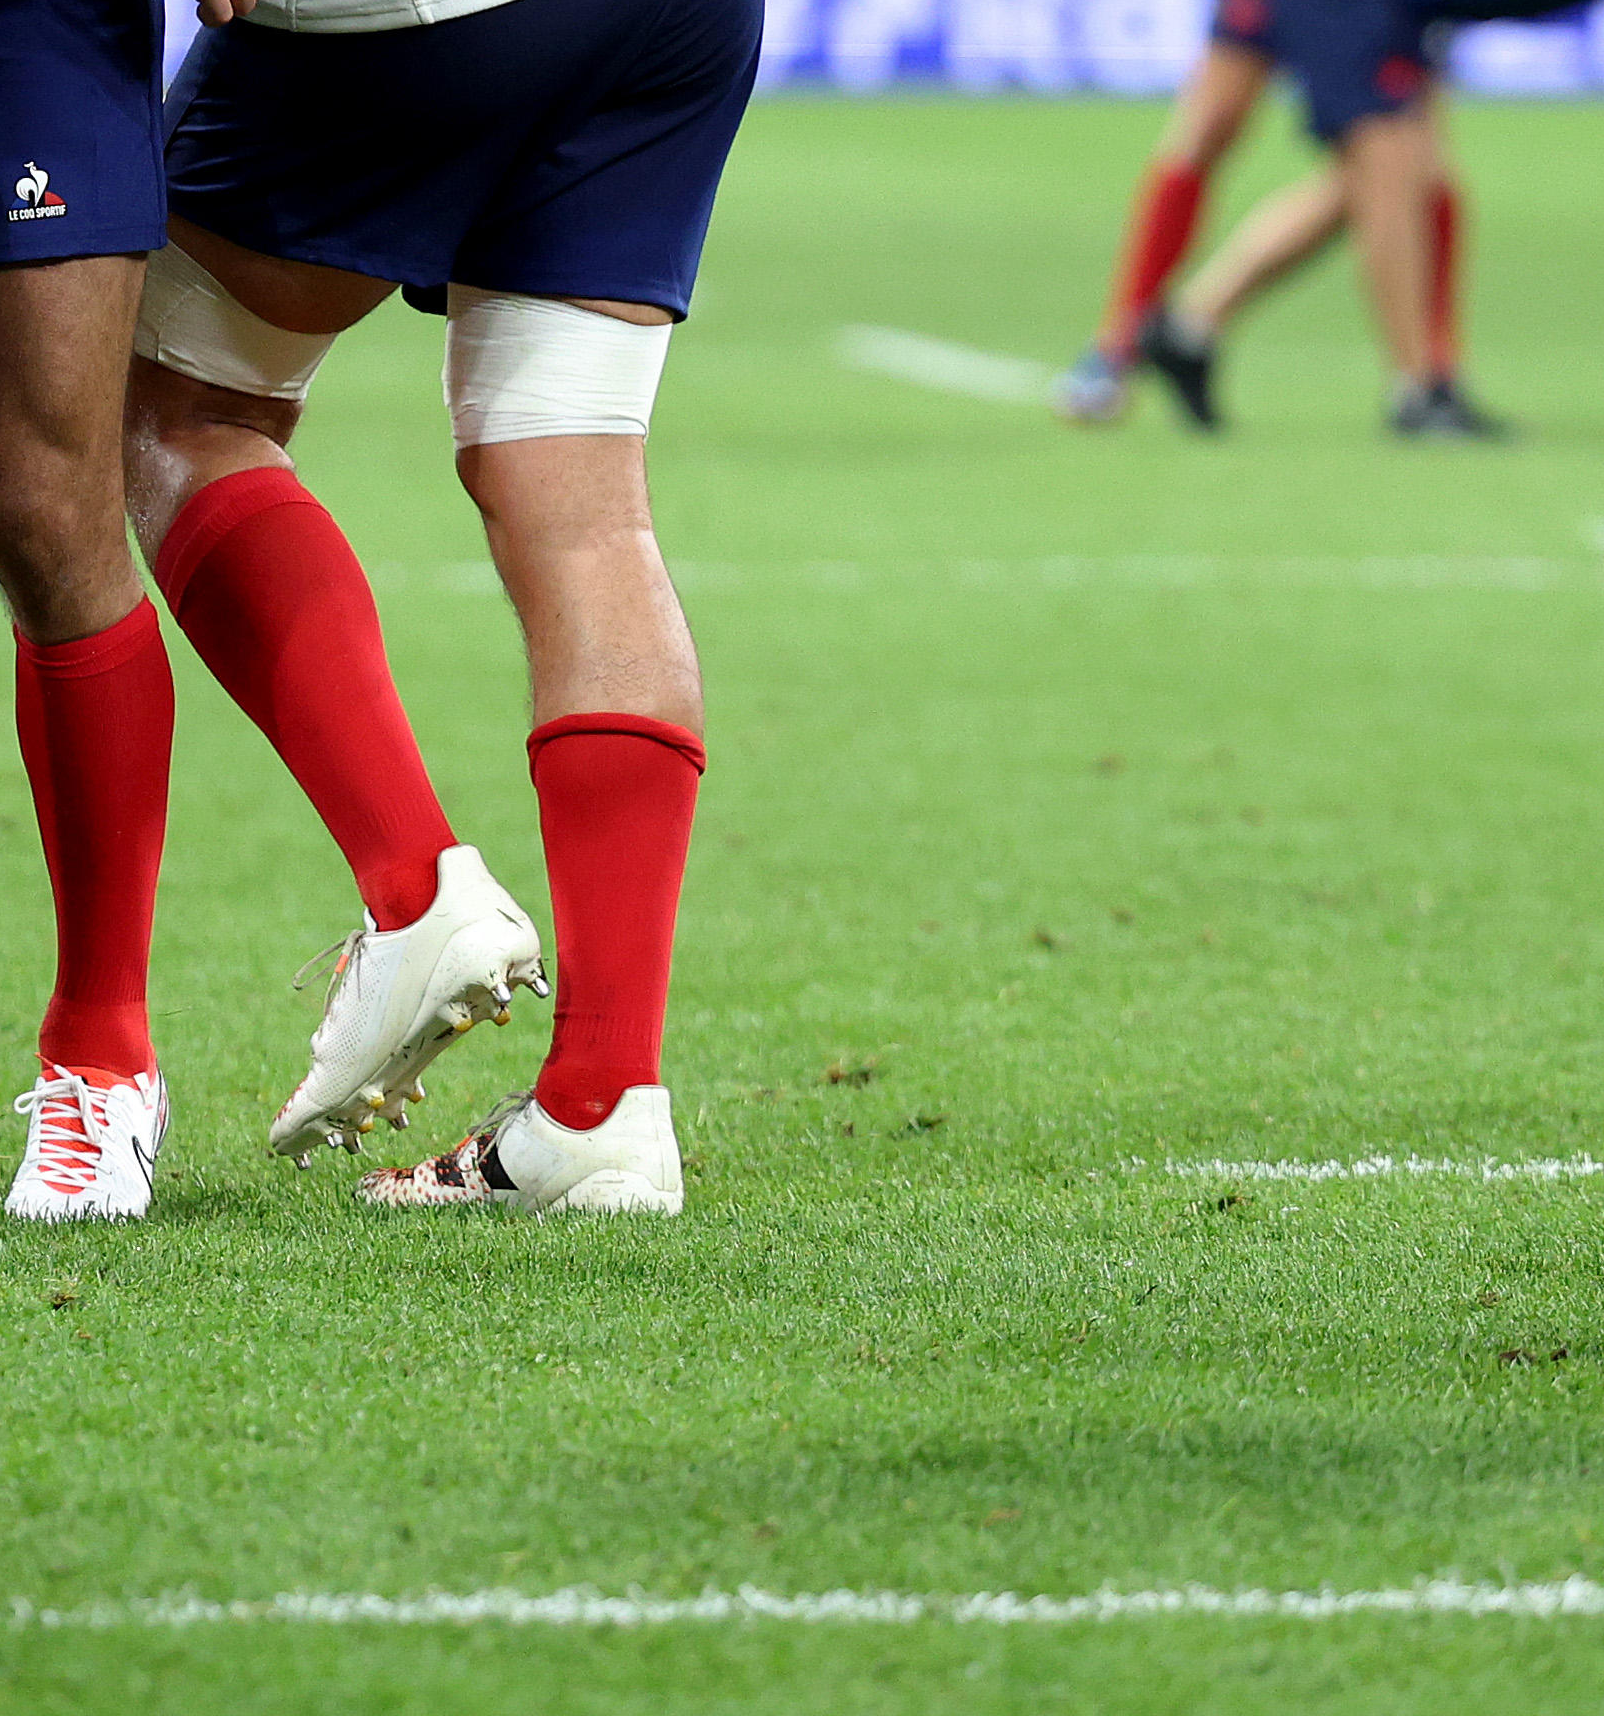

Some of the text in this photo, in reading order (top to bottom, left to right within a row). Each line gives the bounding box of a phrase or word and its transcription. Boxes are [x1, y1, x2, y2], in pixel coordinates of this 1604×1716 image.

[8, 205, 66, 221] LE COQ SPORTIF
